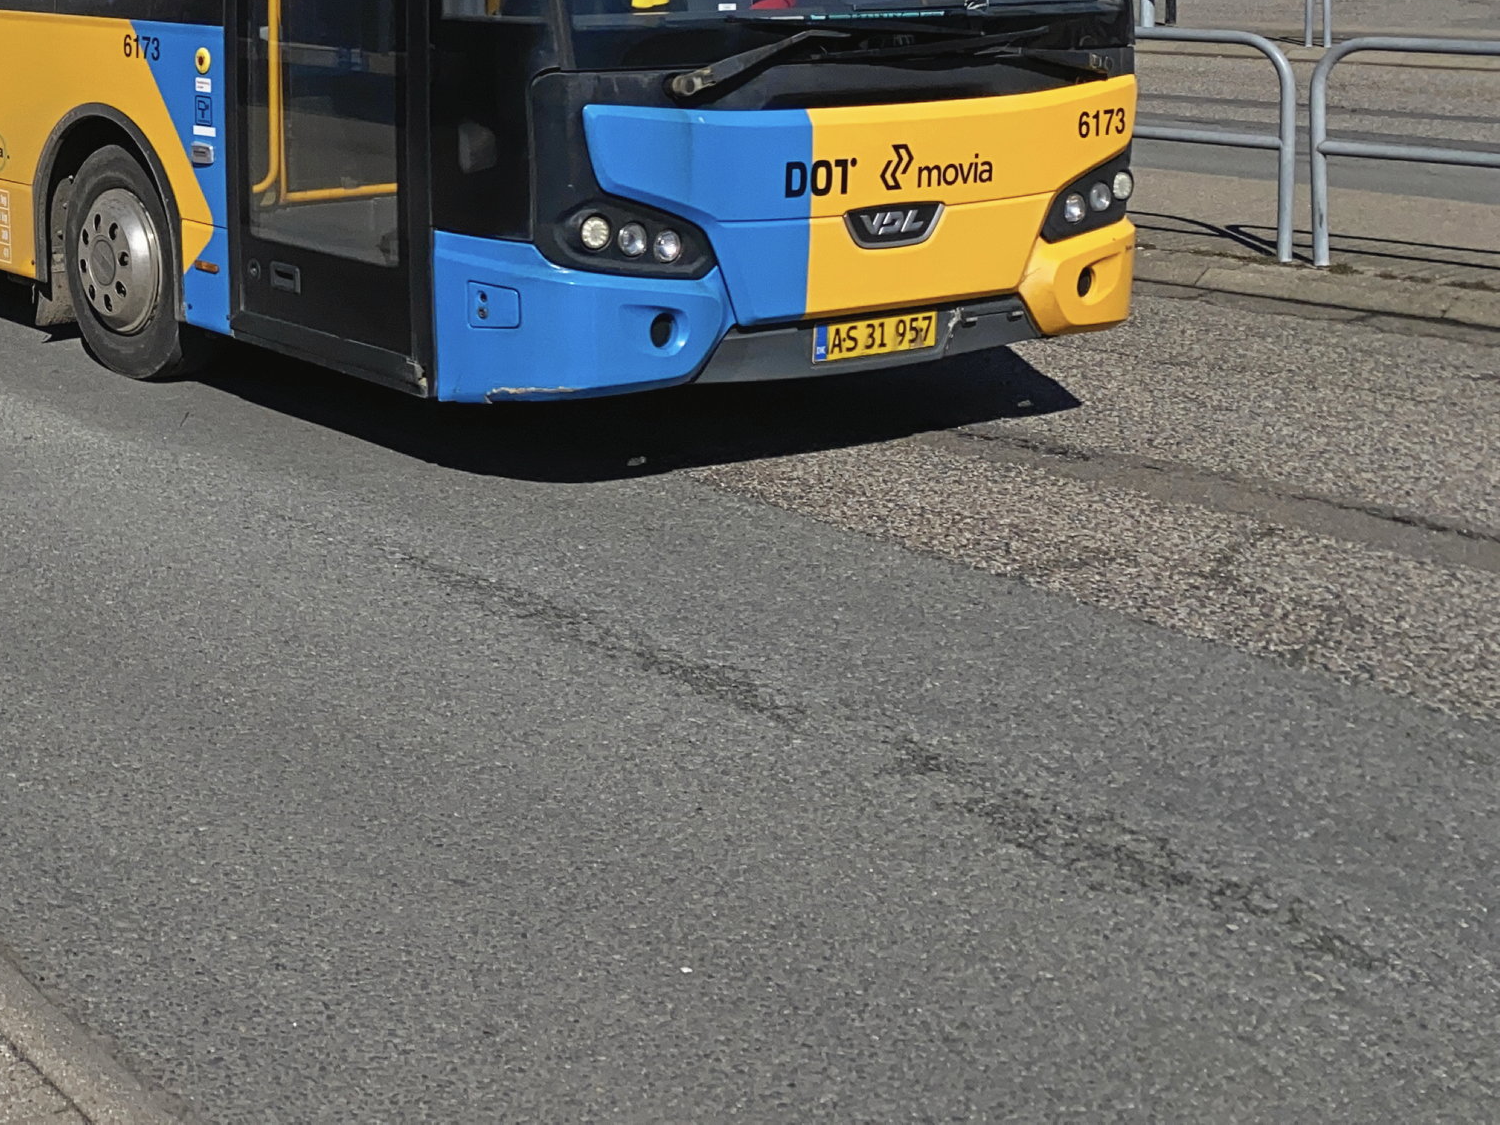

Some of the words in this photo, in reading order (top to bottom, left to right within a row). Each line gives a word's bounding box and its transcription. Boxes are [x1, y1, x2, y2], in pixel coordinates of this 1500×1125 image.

[123, 34, 160, 61] 6173
[1078, 107, 1125, 139] 6173
[785, 158, 857, 198] DOT
[917, 153, 993, 188] movia
[860, 209, 924, 235] VDL
[830, 325, 859, 354] AS
[865, 322, 887, 350] 31
[895, 315, 933, 347] 957
